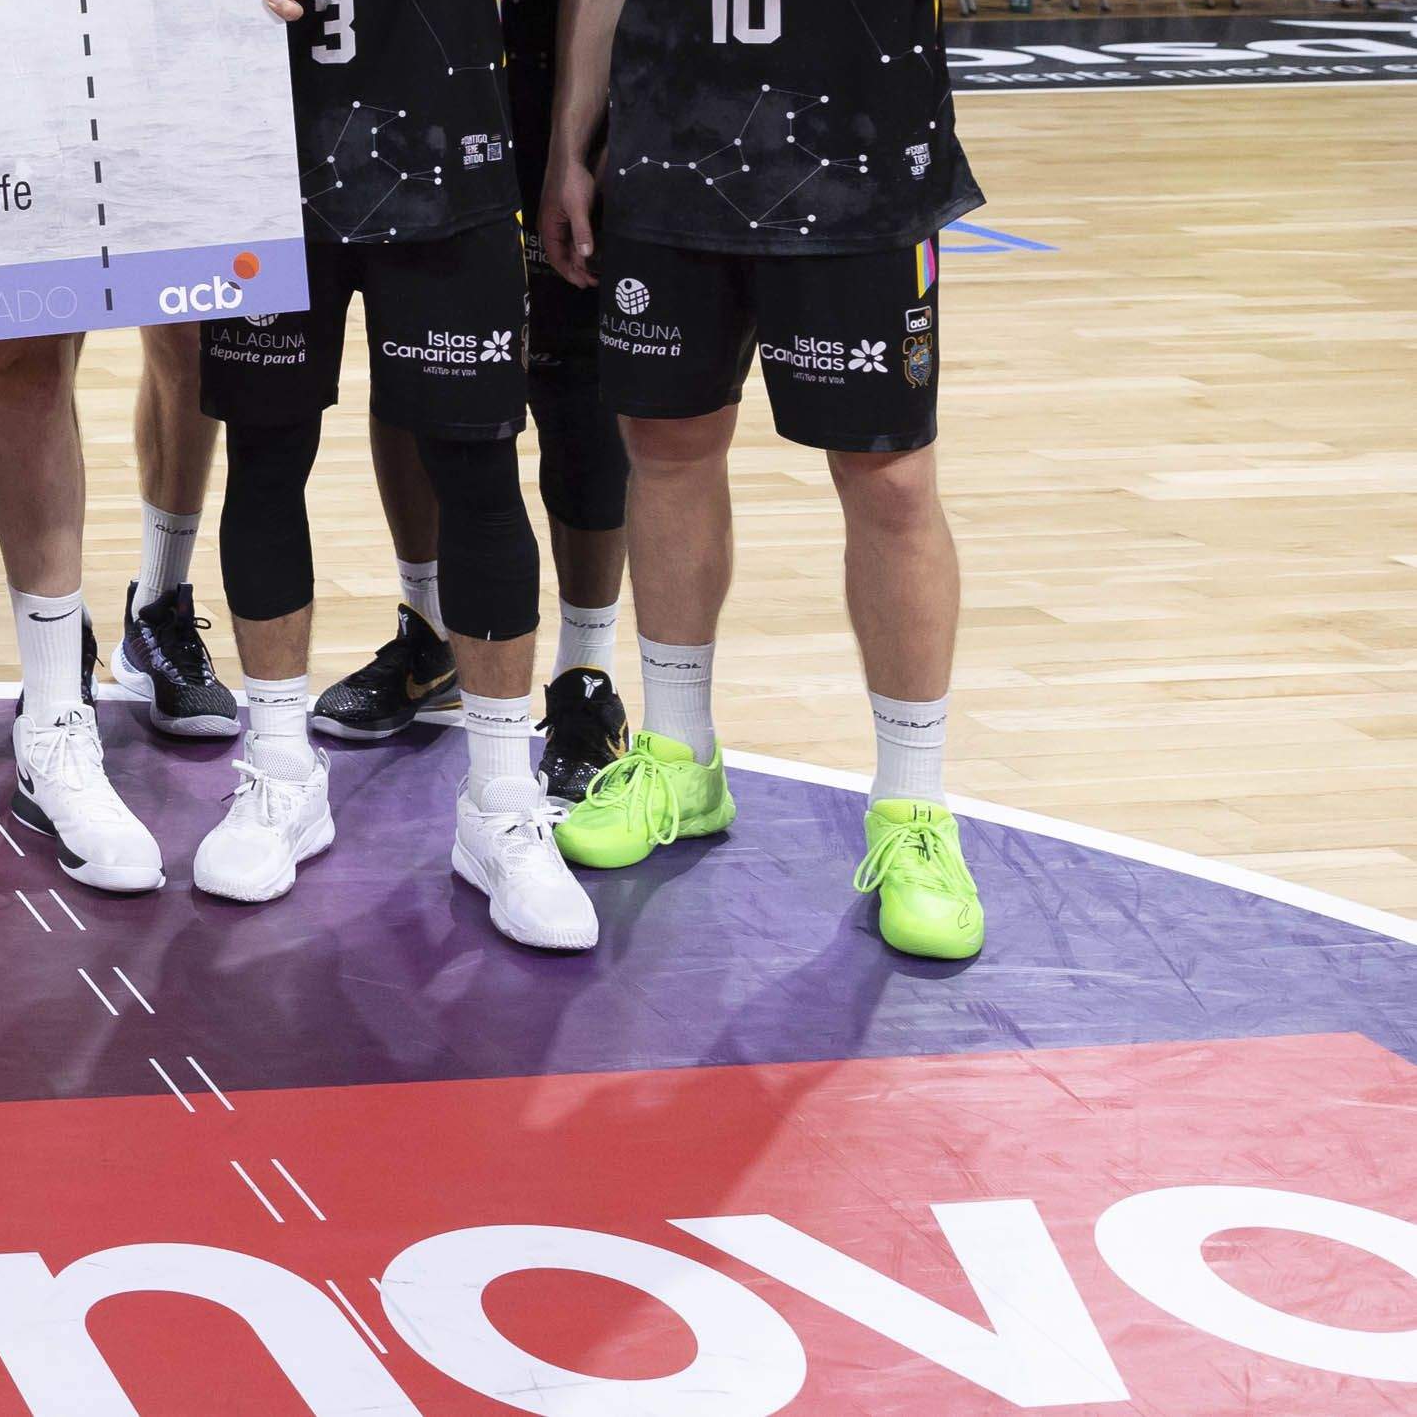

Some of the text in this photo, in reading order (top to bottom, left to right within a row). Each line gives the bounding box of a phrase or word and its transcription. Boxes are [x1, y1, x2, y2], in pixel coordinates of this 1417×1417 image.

[1151, 64, 1373, 80] nuestra
[159, 276, 243, 316] acb
[611, 321, 682, 341] LAGUNA
[910, 315, 927, 328] acb
[211, 329, 306, 349] LA LAGUNA
[428, 330, 477, 348] Islas
[633, 341, 667, 356] para
[670, 343, 681, 357] ti
[794, 334, 845, 355] Islas
[210, 346, 306, 366] deporte para ti
[382, 341, 477, 365] Canarias
[760, 343, 846, 372] Canarias
